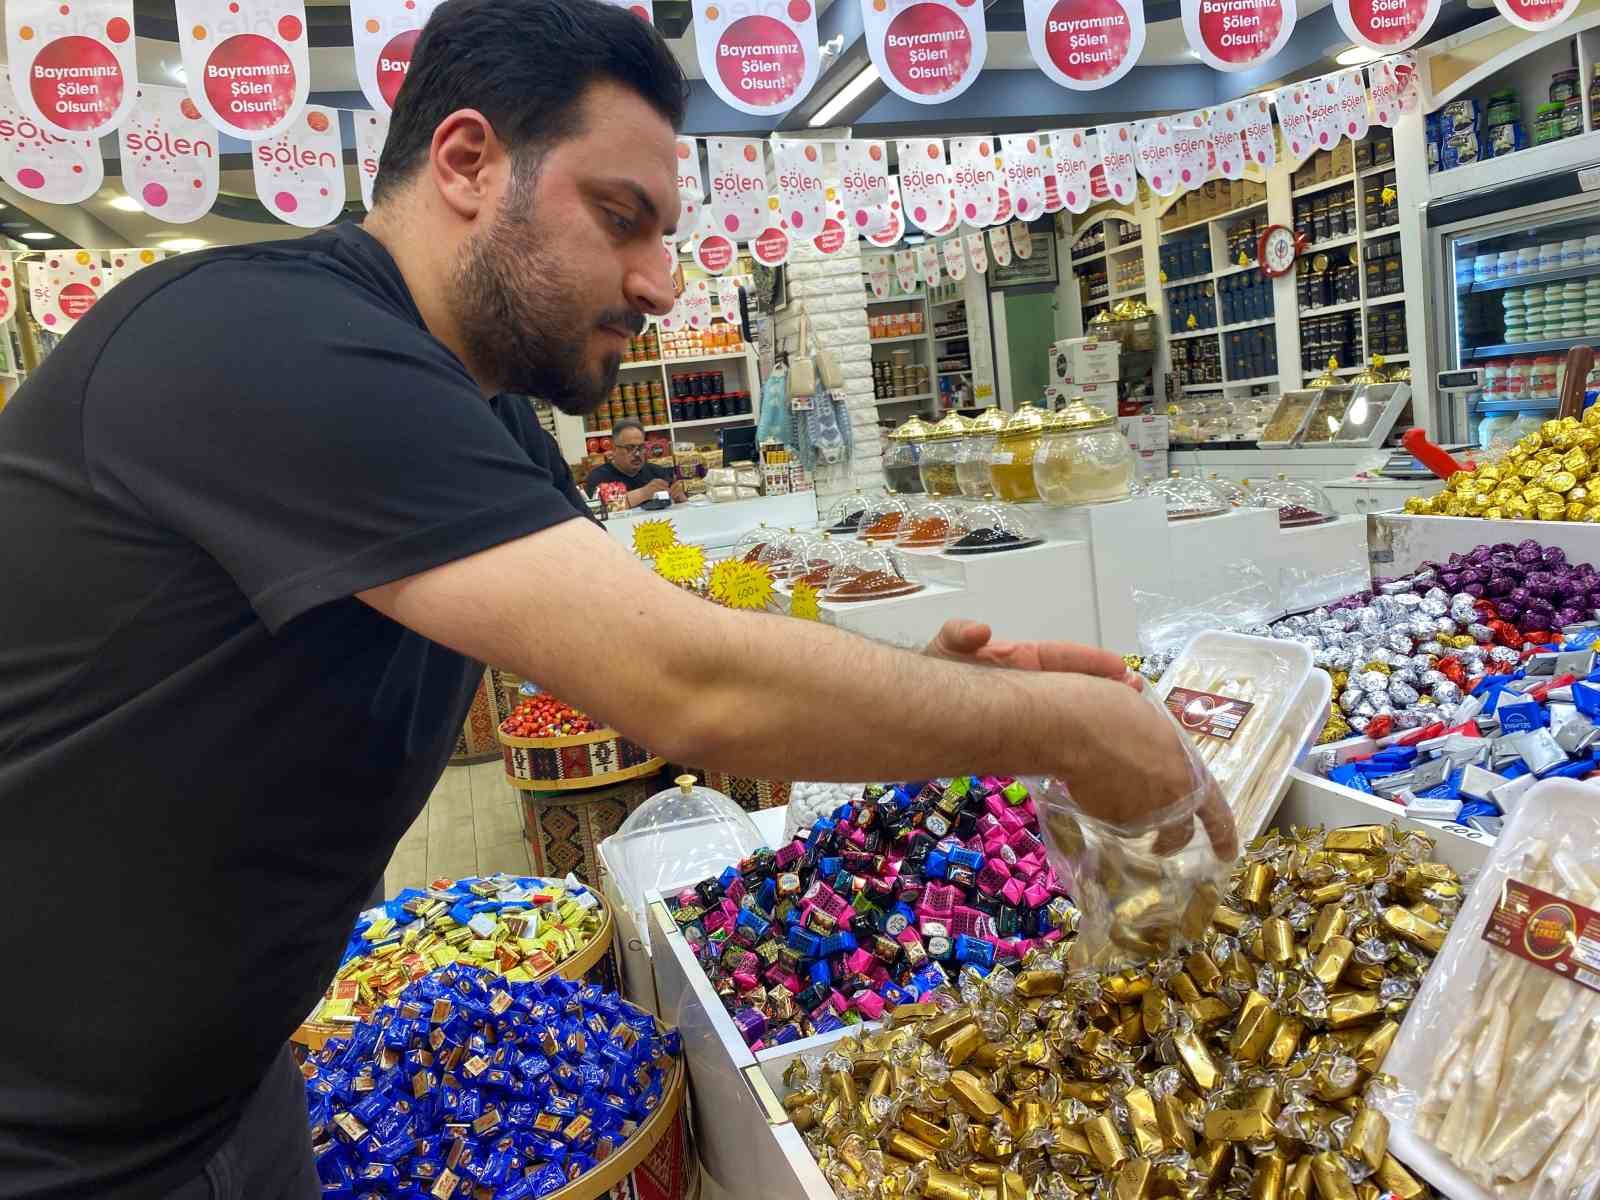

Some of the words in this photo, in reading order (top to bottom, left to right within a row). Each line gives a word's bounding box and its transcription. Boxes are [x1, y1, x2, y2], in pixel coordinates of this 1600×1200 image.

[1048, 15, 1125, 33] Bayramınız
[1222, 15, 1260, 32] Şölen
[887, 28, 966, 48] Bayramınız
[1069, 33, 1109, 50] Şölen
[1220, 30, 1263, 47] Olsun!
[719, 43, 800, 59] Bayramınız
[908, 48, 949, 65] Şölen
[1068, 48, 1113, 65] Olsun!
[34, 65, 119, 81] Bayramınız
[207, 64, 290, 79] Bayramınız
[741, 59, 782, 76] Şölen
[908, 63, 953, 79] Olsun!
[57, 82, 99, 99] Şölen
[231, 81, 273, 98] Şölen
[740, 77, 785, 90] Olsun!
[55, 101, 103, 113] Olsun!
[230, 99, 277, 113] Olsun!
